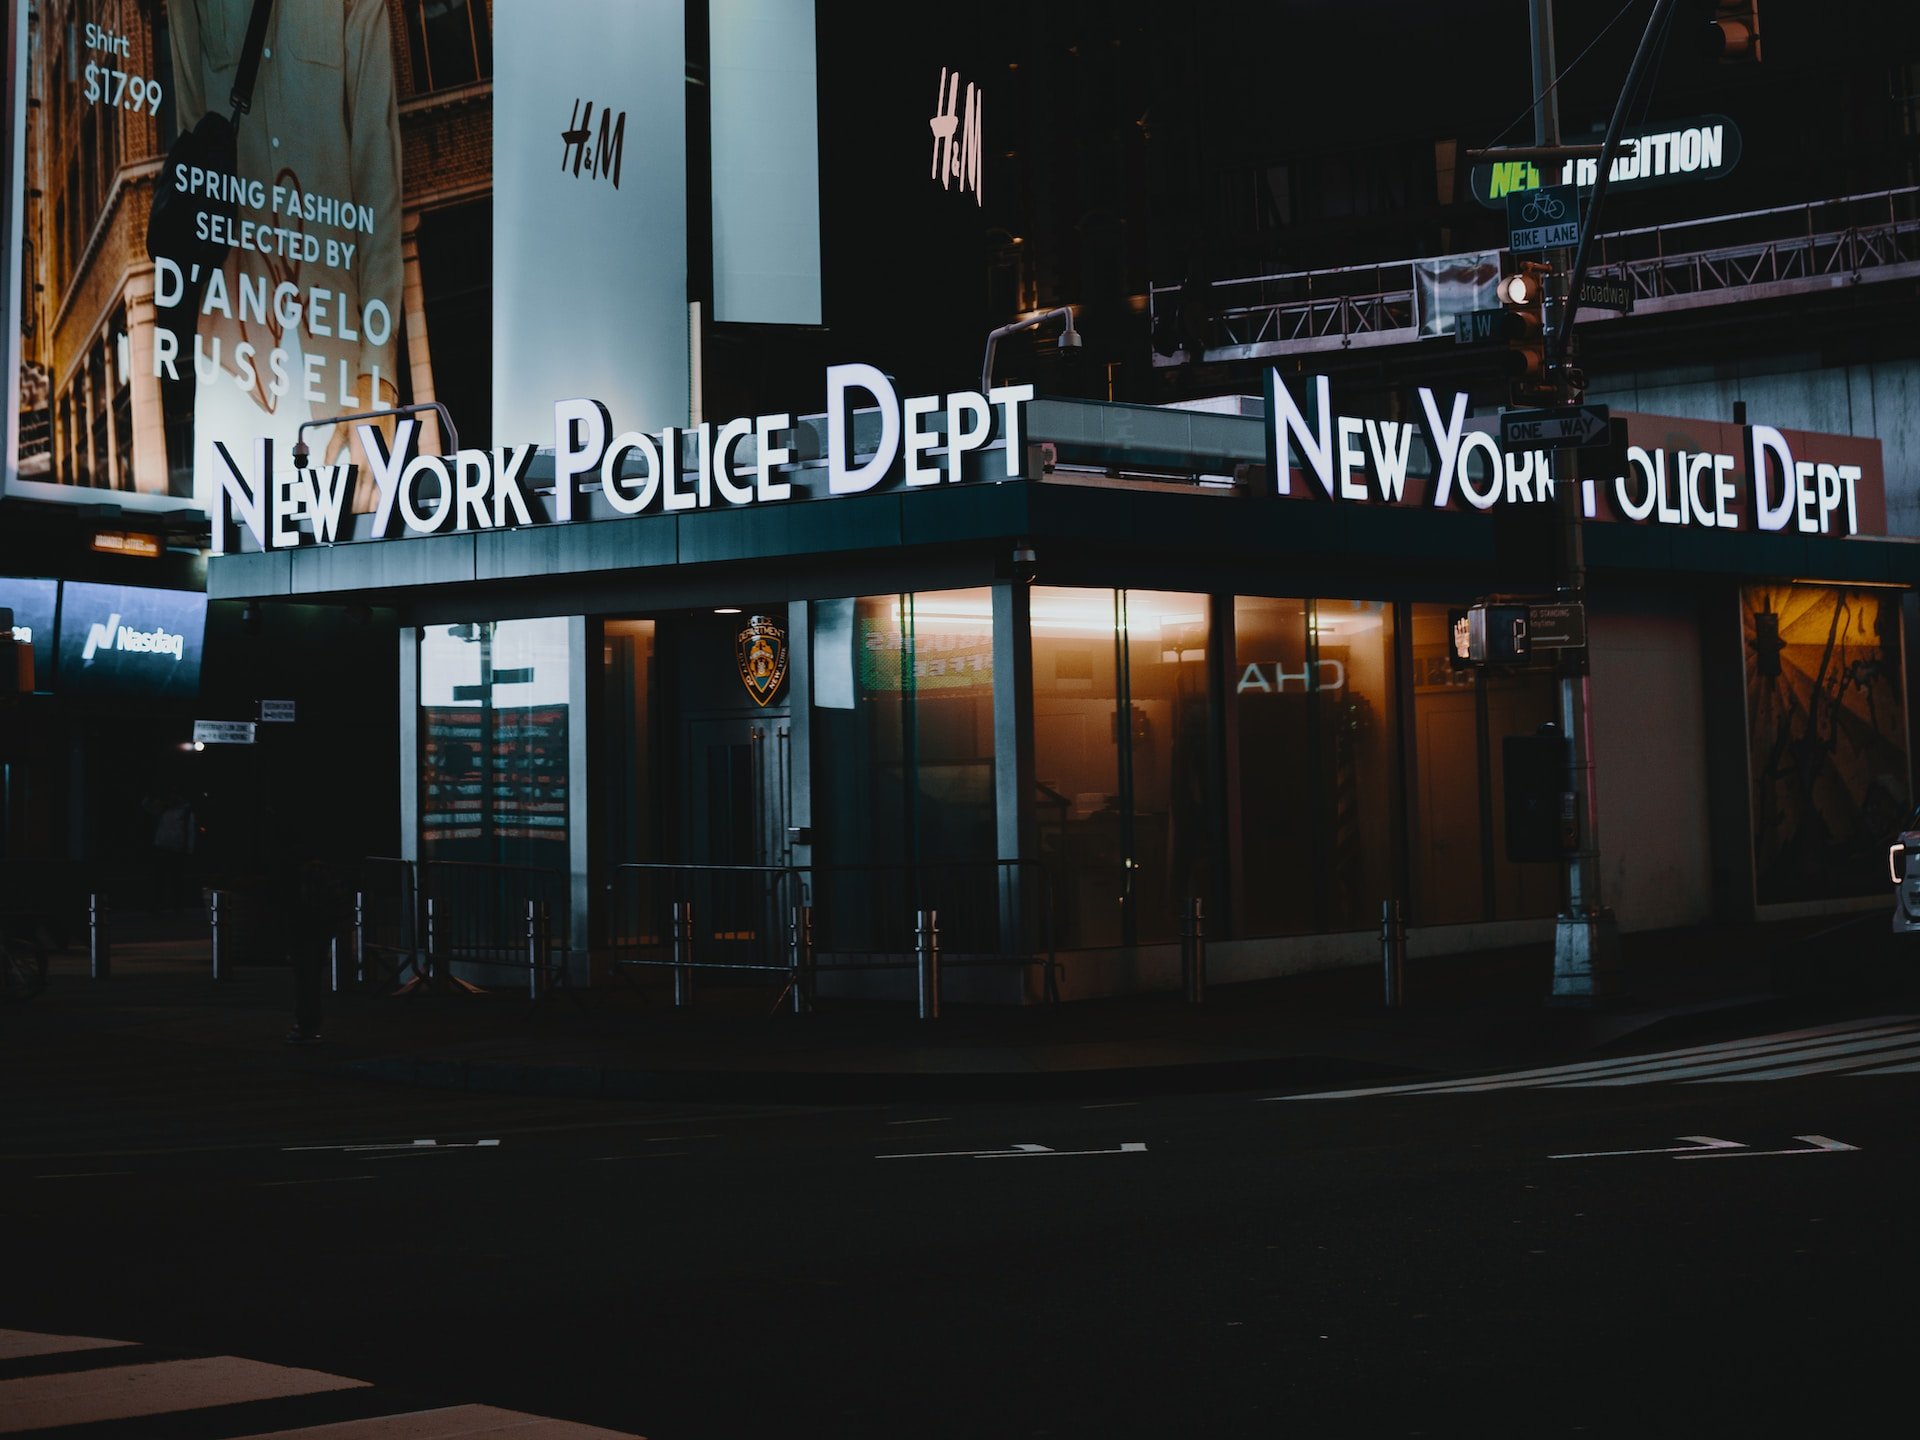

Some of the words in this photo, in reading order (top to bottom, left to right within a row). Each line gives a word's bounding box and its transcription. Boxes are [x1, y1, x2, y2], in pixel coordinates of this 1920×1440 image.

[85, 22, 130, 58] Shirt
[84, 60, 163, 117] $17.99
[561, 98, 626, 190] H&M
[929, 65, 983, 208] H&M
[175, 163, 265, 209] SPRING
[272, 185, 374, 234] FASHION
[195, 211, 320, 263] SELECTED
[325, 238, 356, 271] BY
[1513, 229, 1540, 248] BIKE
[1545, 224, 1577, 243] LANE
[154, 255, 392, 346] D'ANGELO
[1476, 314, 1491, 337] W
[153, 326, 392, 411] RUSSELL
[211, 437, 353, 556] NEW
[356, 418, 536, 539] YORK
[554, 397, 792, 522] POLICE
[826, 361, 1035, 495] DEPT
[1271, 366, 1413, 503] NEW
[1582, 445, 1739, 529] OLICE
[1749, 424, 1863, 536] DEPT
[1510, 423, 1542, 440] ONE
[1560, 417, 1594, 436] WAY
[116, 625, 184, 661] Nasdaq
